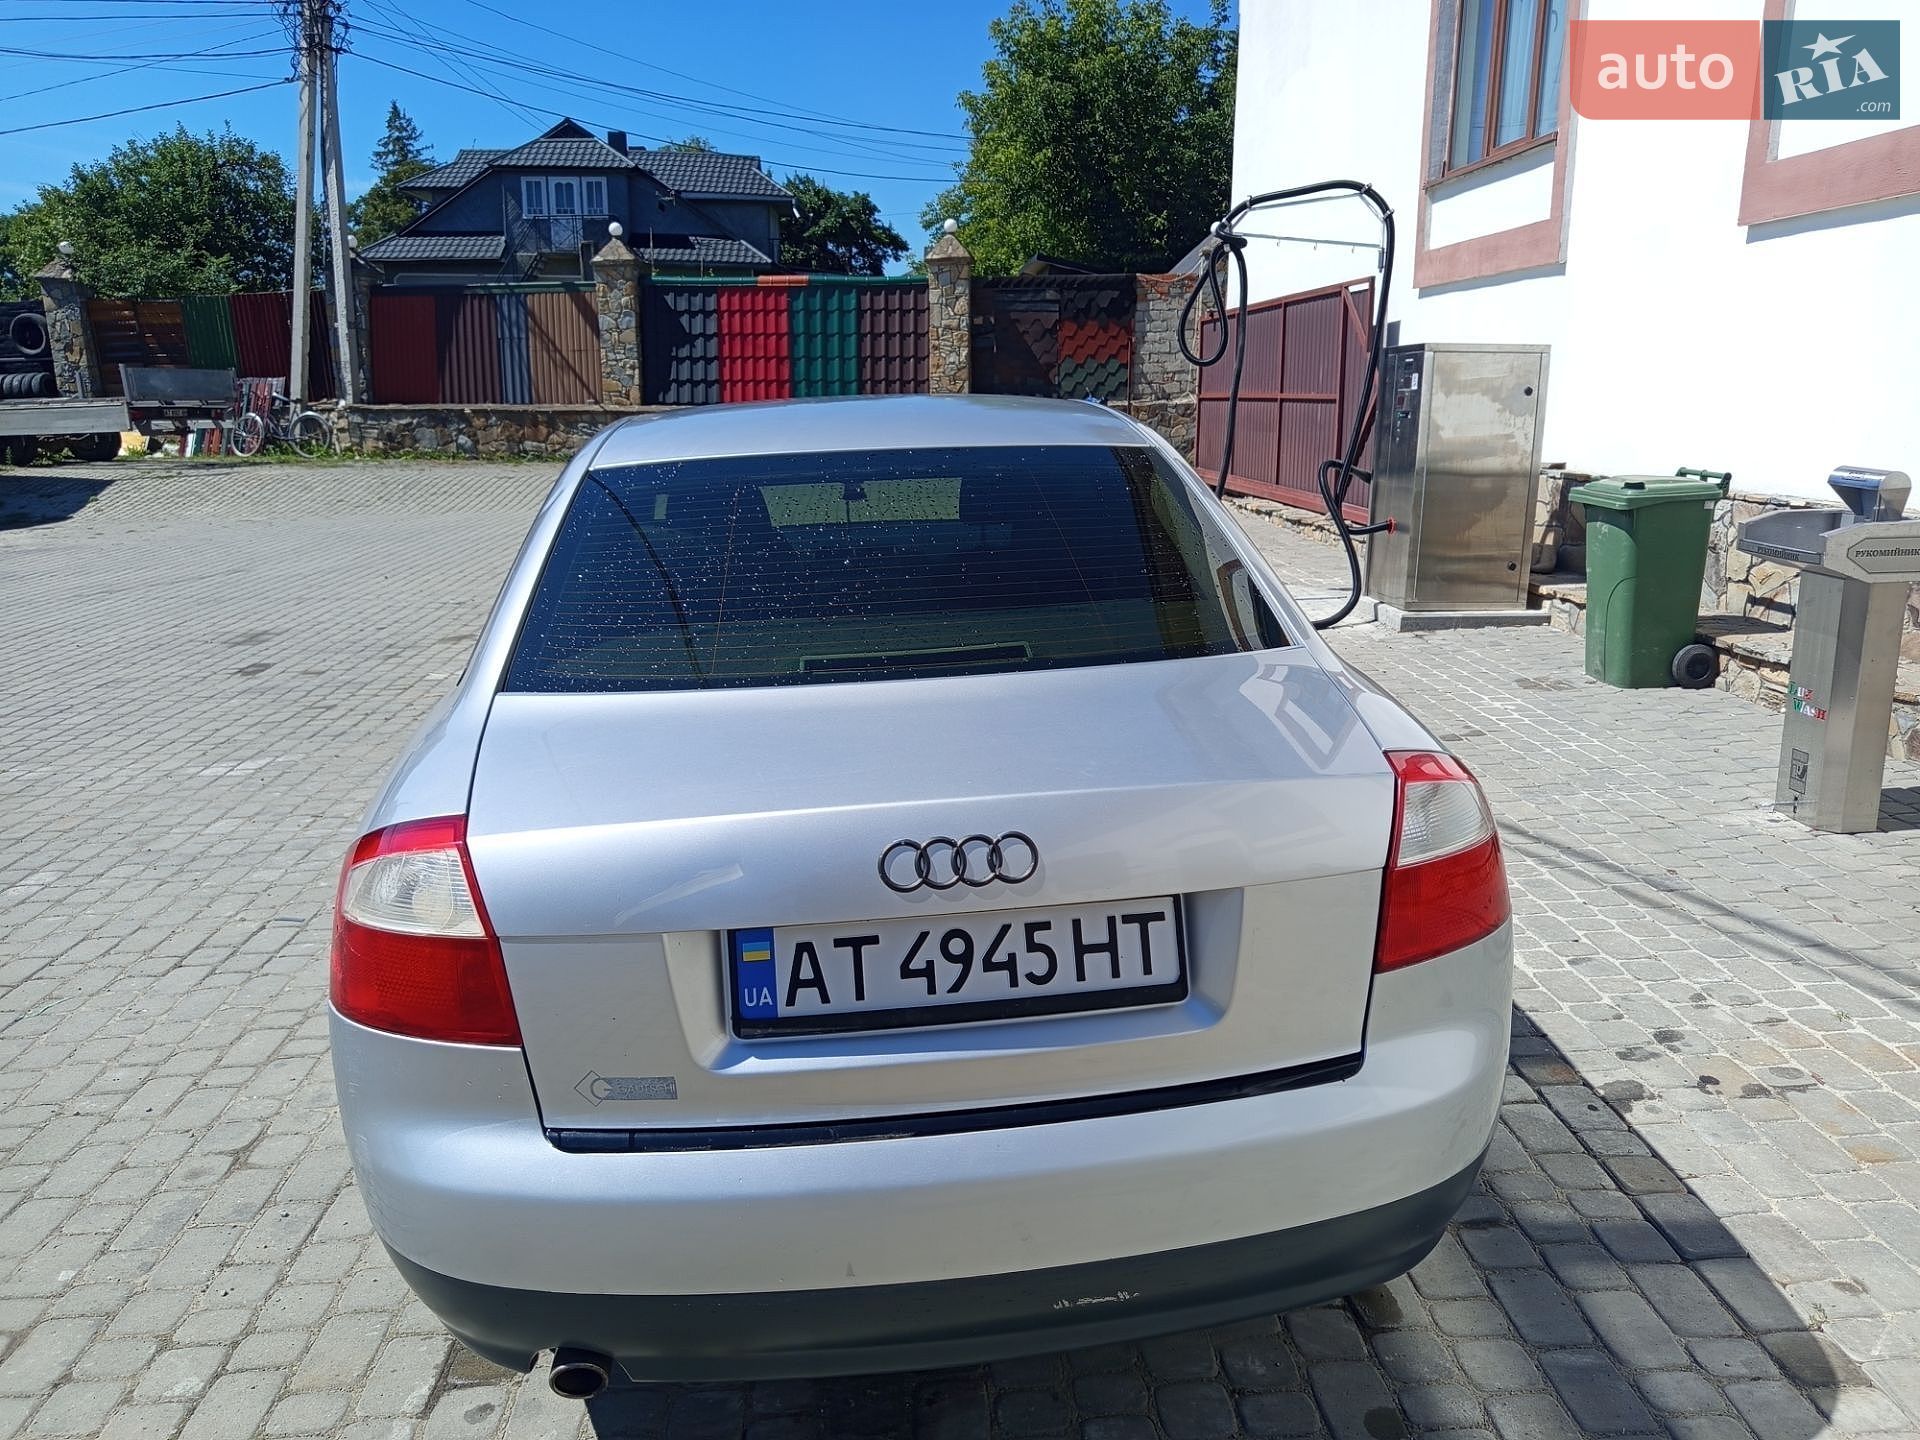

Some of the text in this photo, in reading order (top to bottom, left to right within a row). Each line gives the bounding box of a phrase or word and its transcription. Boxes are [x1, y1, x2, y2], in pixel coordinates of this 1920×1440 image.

[1792, 697, 1827, 721] WASH
[785, 912, 1166, 1007] AT 4945 HT
[744, 988, 773, 1007] UA
